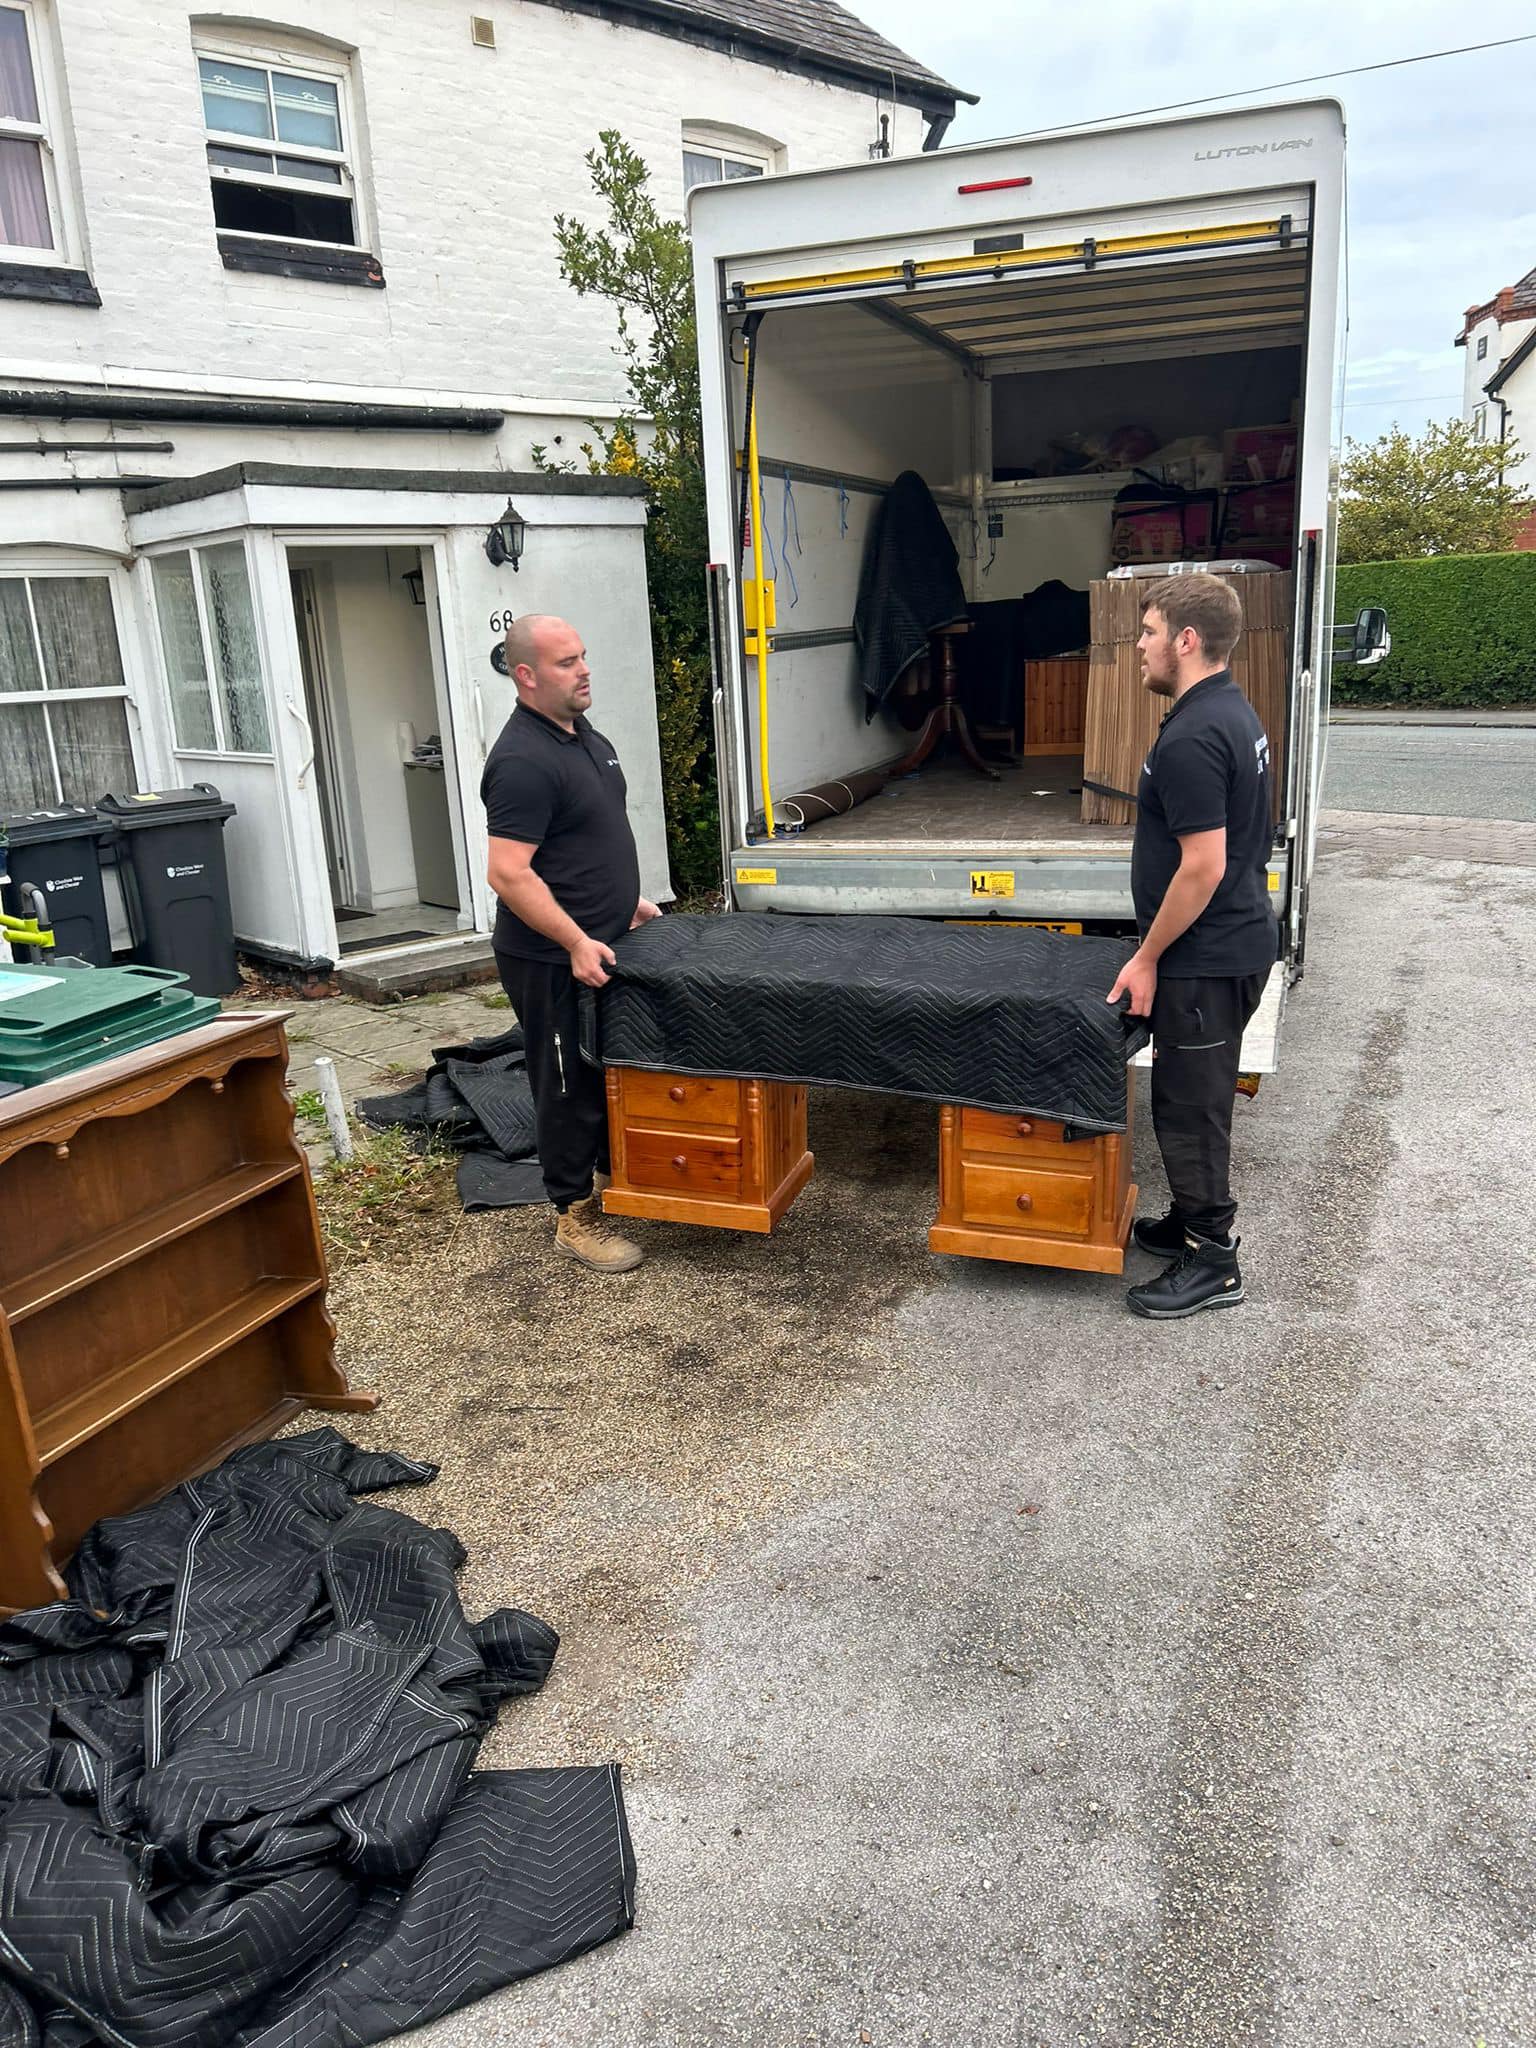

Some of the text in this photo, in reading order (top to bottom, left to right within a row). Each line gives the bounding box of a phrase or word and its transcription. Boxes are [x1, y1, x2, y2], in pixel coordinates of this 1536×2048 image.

[1194, 138, 1314, 161] LUTON VAN
[490, 610, 514, 632] 68
